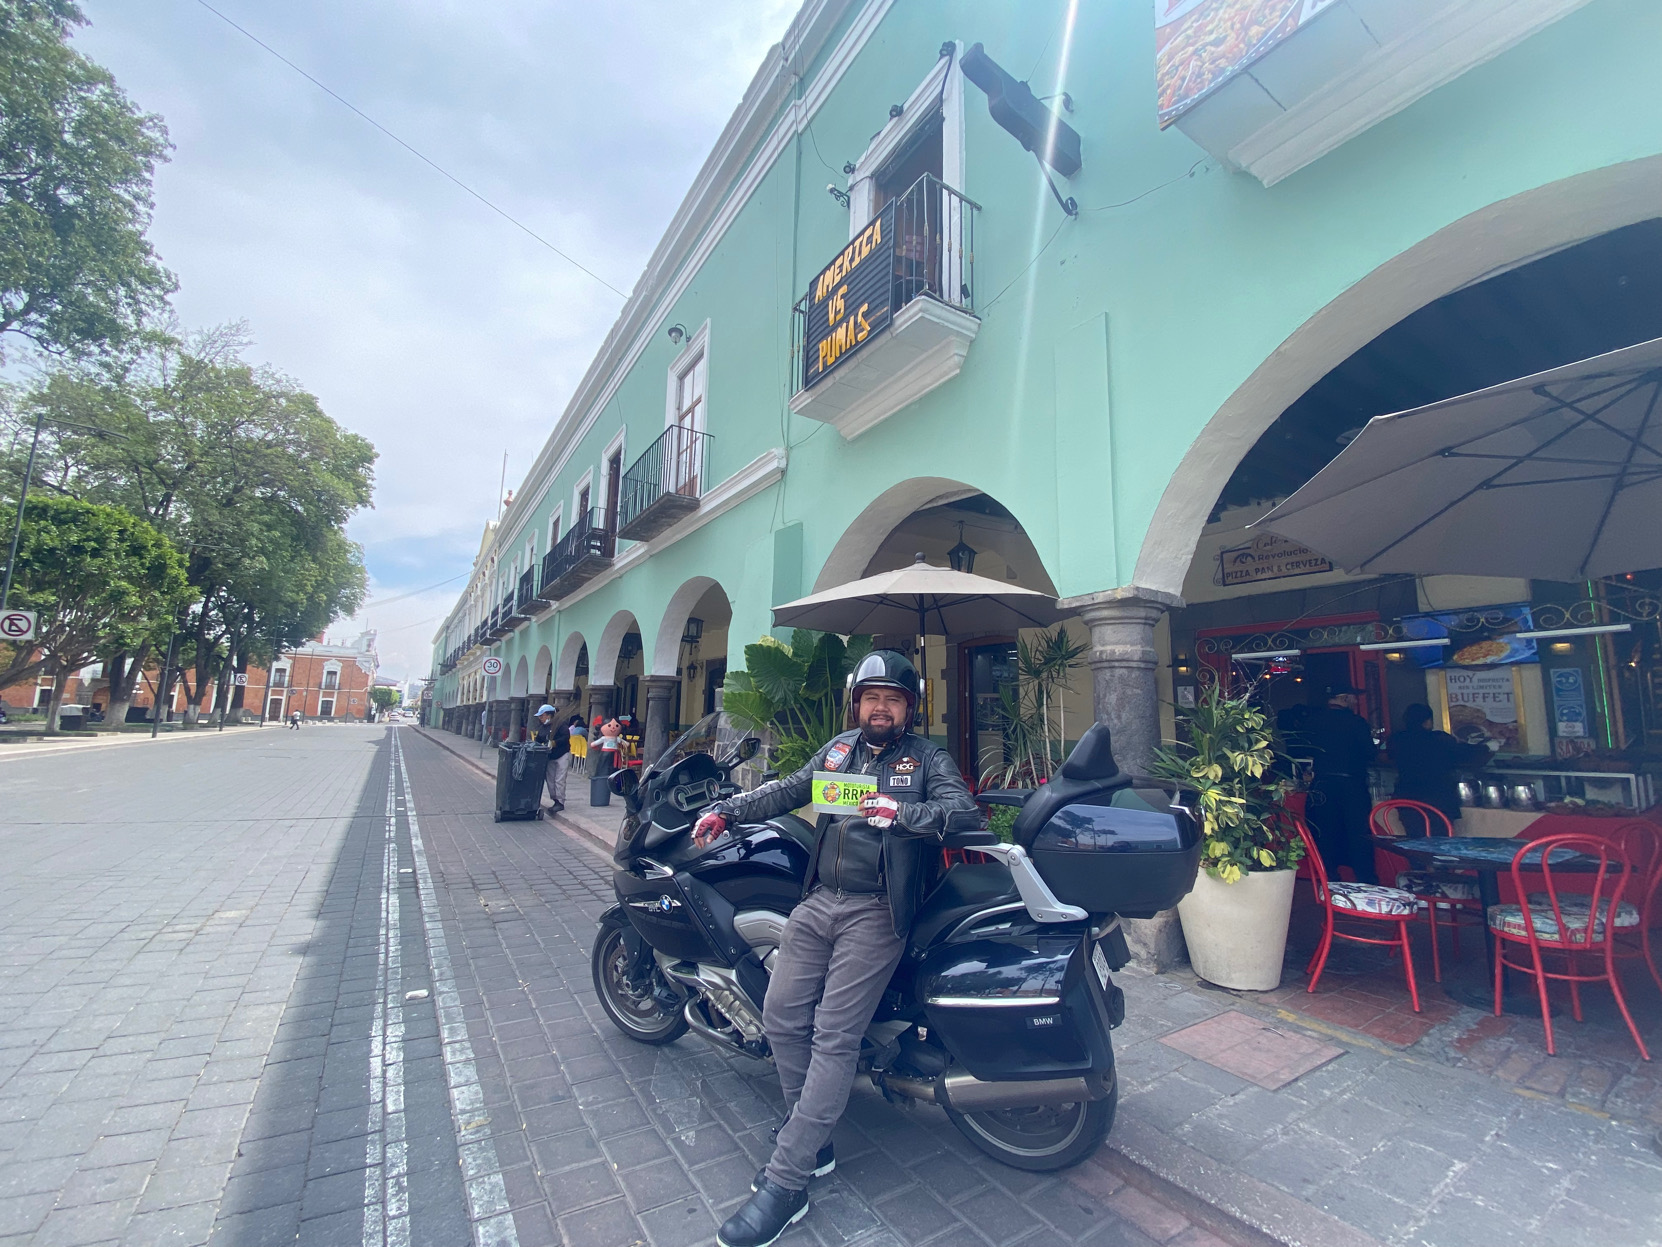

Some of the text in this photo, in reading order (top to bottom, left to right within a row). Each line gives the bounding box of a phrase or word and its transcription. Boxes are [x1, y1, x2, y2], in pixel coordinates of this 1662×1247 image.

[815, 217, 881, 305] AMERICA
[828, 284, 848, 327] VS
[818, 302, 871, 373] PUMAS
[1255, 565, 1274, 576] PAN
[1276, 564, 1283, 573] &
[1285, 557, 1327, 571] CERVEZA
[1449, 673, 1476, 683] HOY
[1449, 692, 1513, 703] BUFFET
[896, 762, 914, 771] HOG
[1033, 1017, 1053, 1026] BMW
